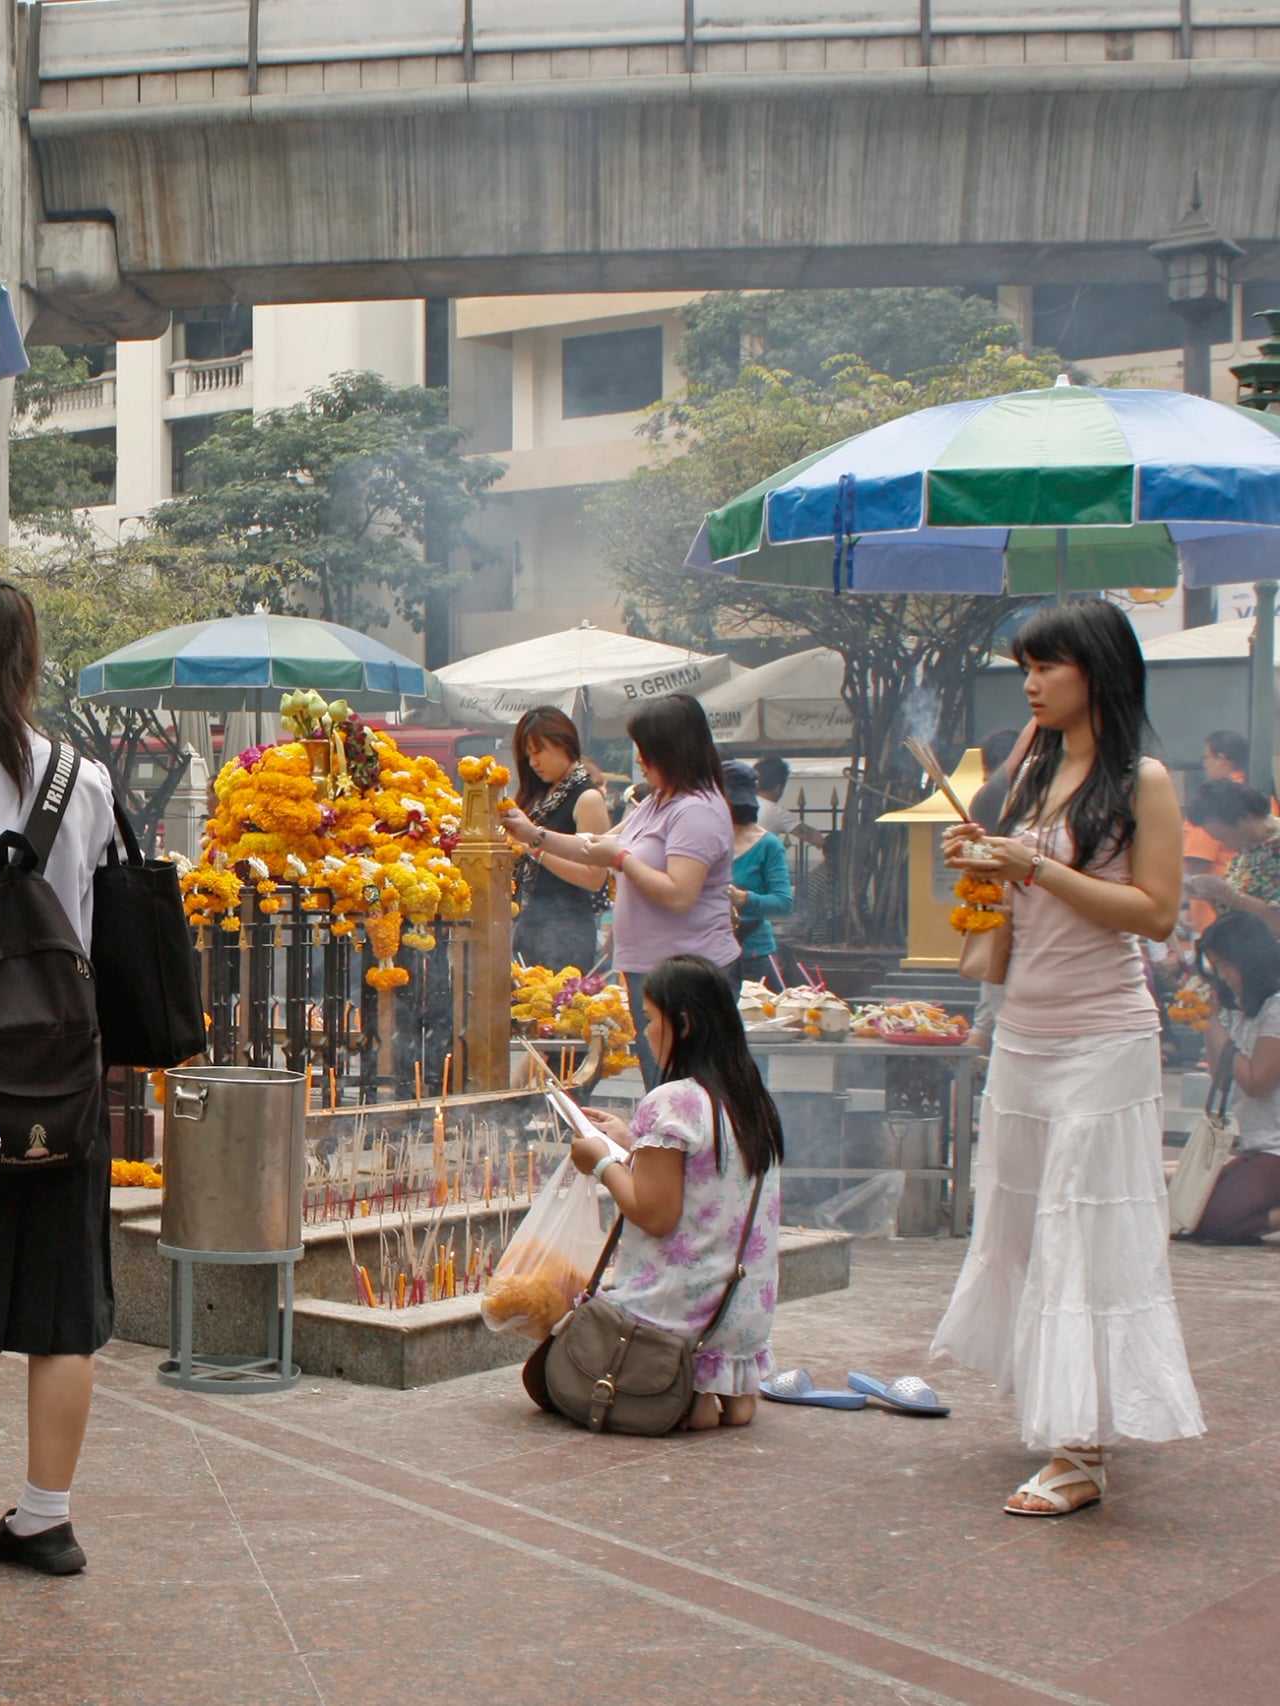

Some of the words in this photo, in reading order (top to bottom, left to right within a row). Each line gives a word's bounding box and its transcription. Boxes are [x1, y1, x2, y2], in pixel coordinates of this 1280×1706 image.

[623, 665, 702, 699] B.GRIMM
[707, 710, 742, 729] GRIMM
[42, 741, 75, 814] TRIAMUD
